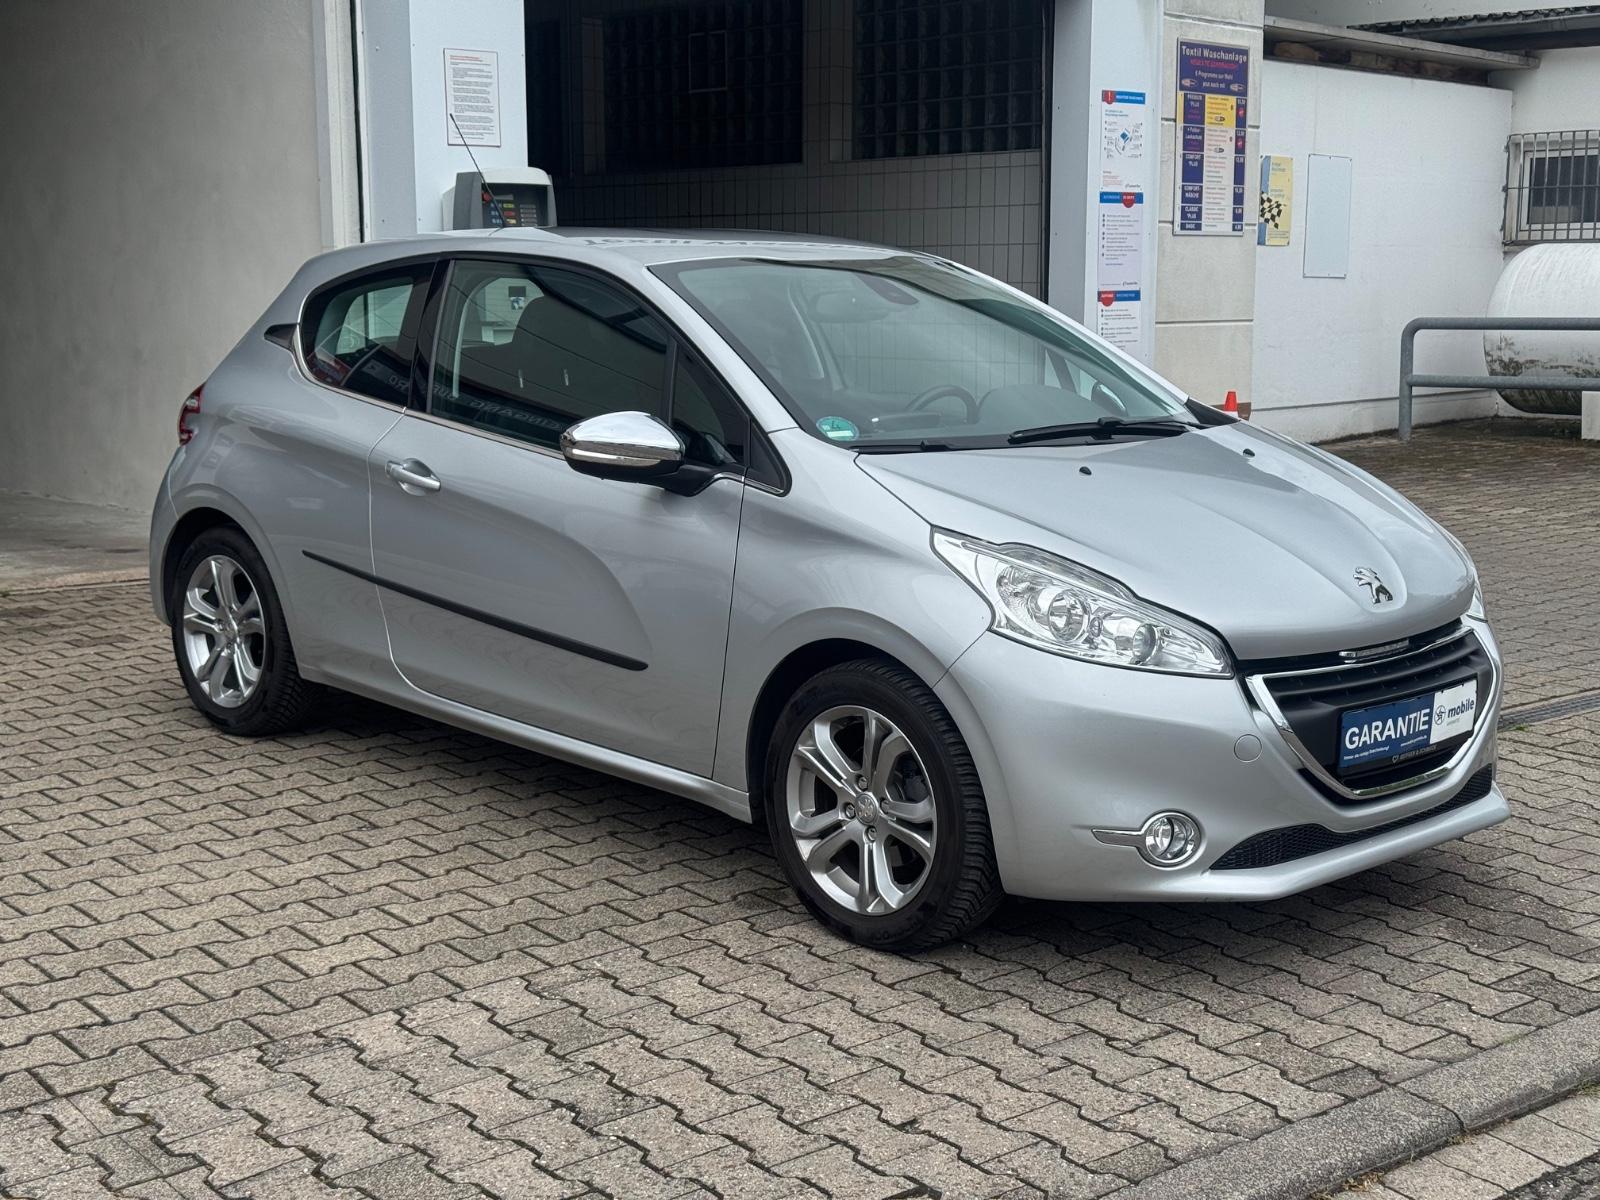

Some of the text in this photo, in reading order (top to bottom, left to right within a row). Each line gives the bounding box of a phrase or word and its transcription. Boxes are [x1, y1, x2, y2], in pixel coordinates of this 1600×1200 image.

[1182, 45, 1247, 63] Textil Waschanlage
[1447, 698, 1475, 719] mobile
[1345, 709, 1430, 749] GARANTIE
